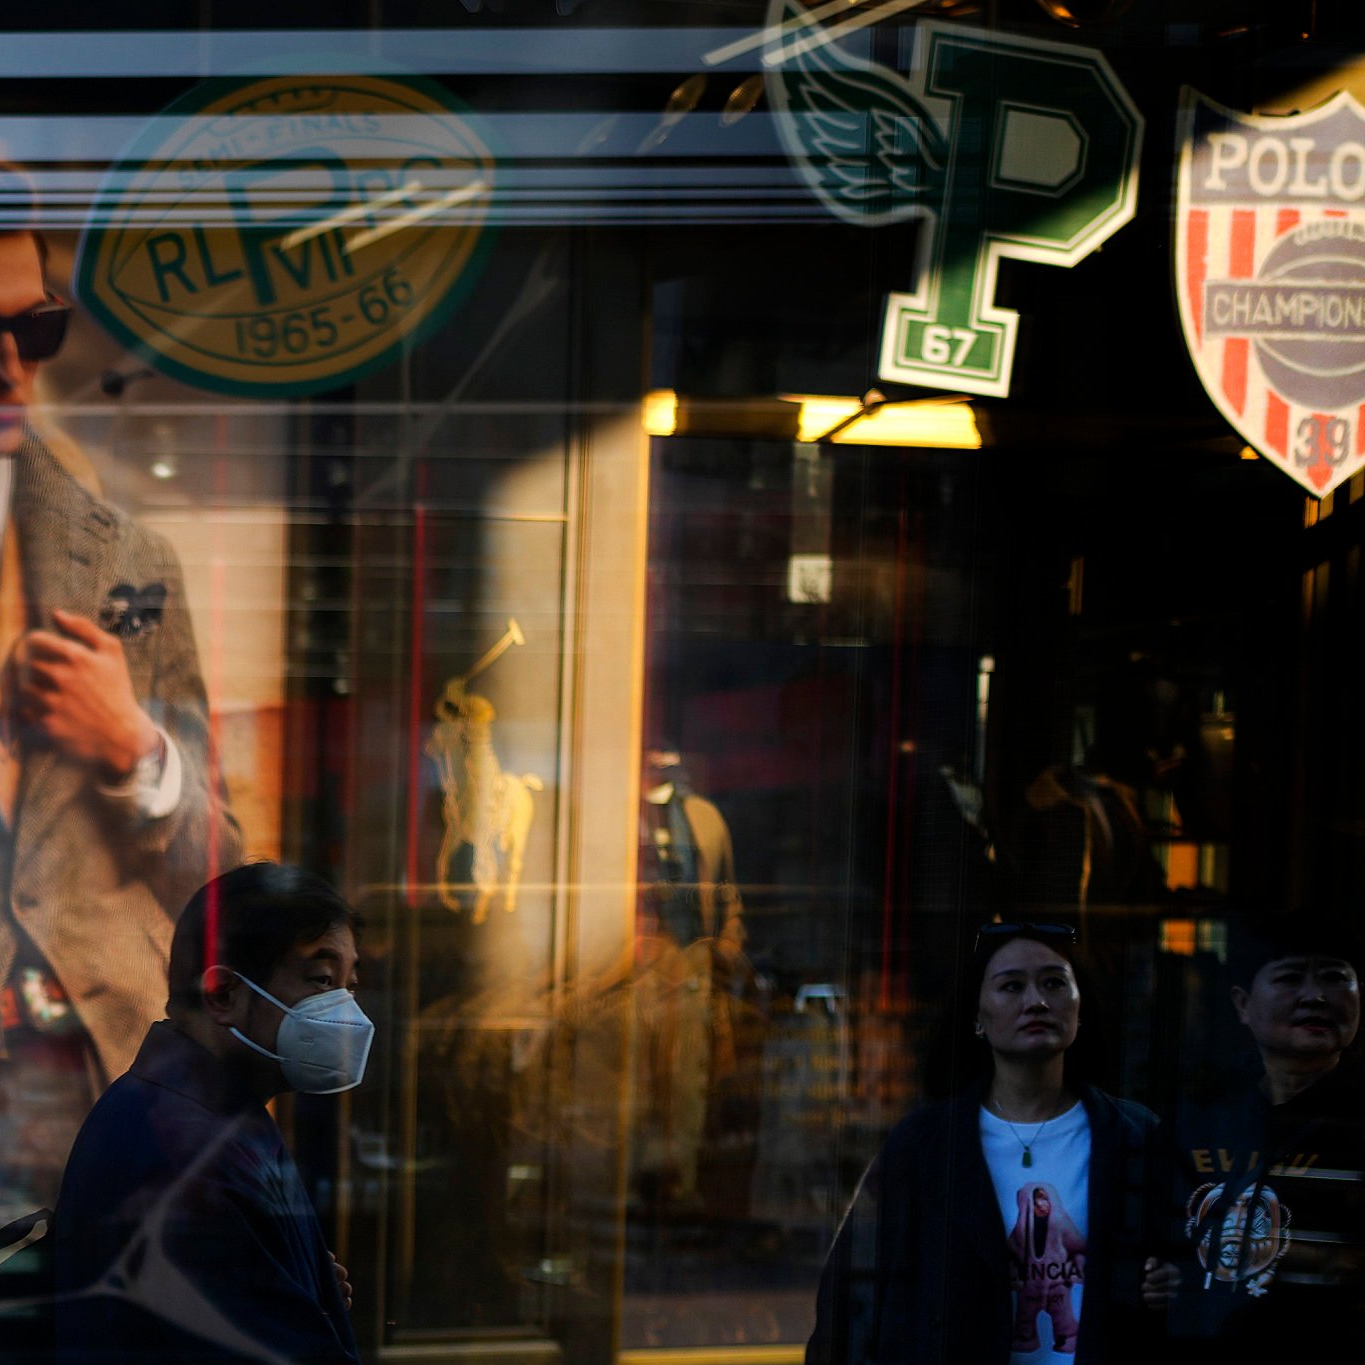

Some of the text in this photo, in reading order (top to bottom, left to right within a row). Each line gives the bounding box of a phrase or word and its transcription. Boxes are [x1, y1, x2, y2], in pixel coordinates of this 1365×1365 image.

[1204, 131, 1365, 200] POLO
[235, 267, 415, 359] 1965-66
[920, 325, 977, 366] 67
